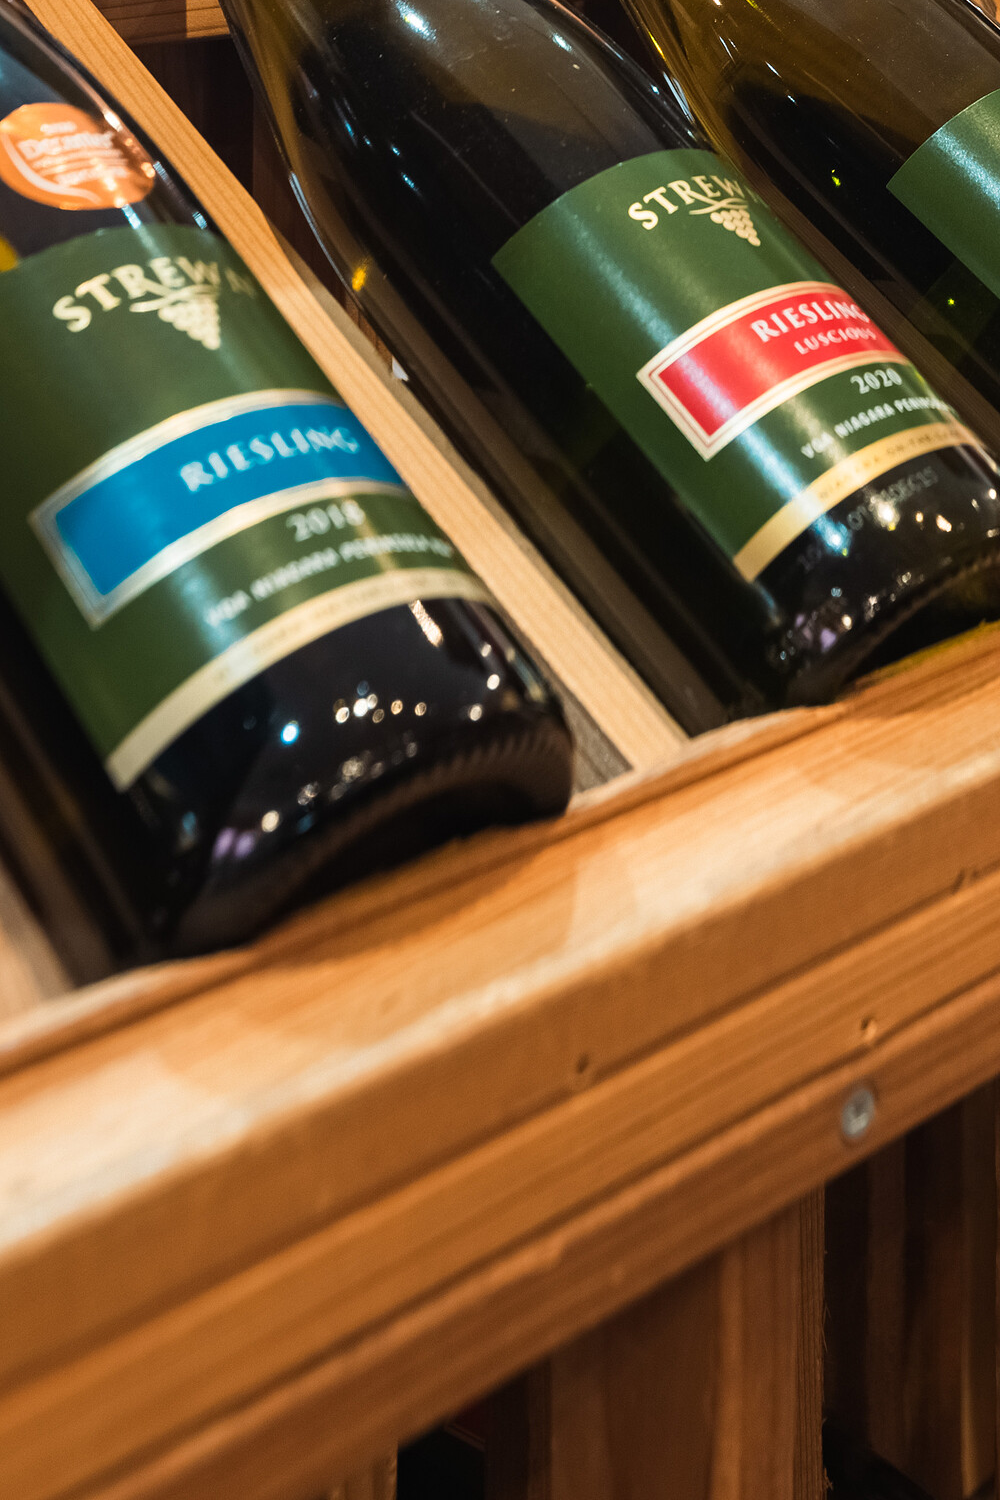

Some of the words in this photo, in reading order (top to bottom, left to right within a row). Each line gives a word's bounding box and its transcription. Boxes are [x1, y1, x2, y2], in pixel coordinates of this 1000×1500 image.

[628, 174, 758, 231] STREW
[750, 300, 870, 343] RIESLING
[793, 325, 877, 355] LUSCIOUS
[850, 367, 903, 395] 2020
[833, 402, 896, 439] NIAGARA
[179, 426, 360, 492] RIESLING
[250, 546, 341, 601] NIAGARA
